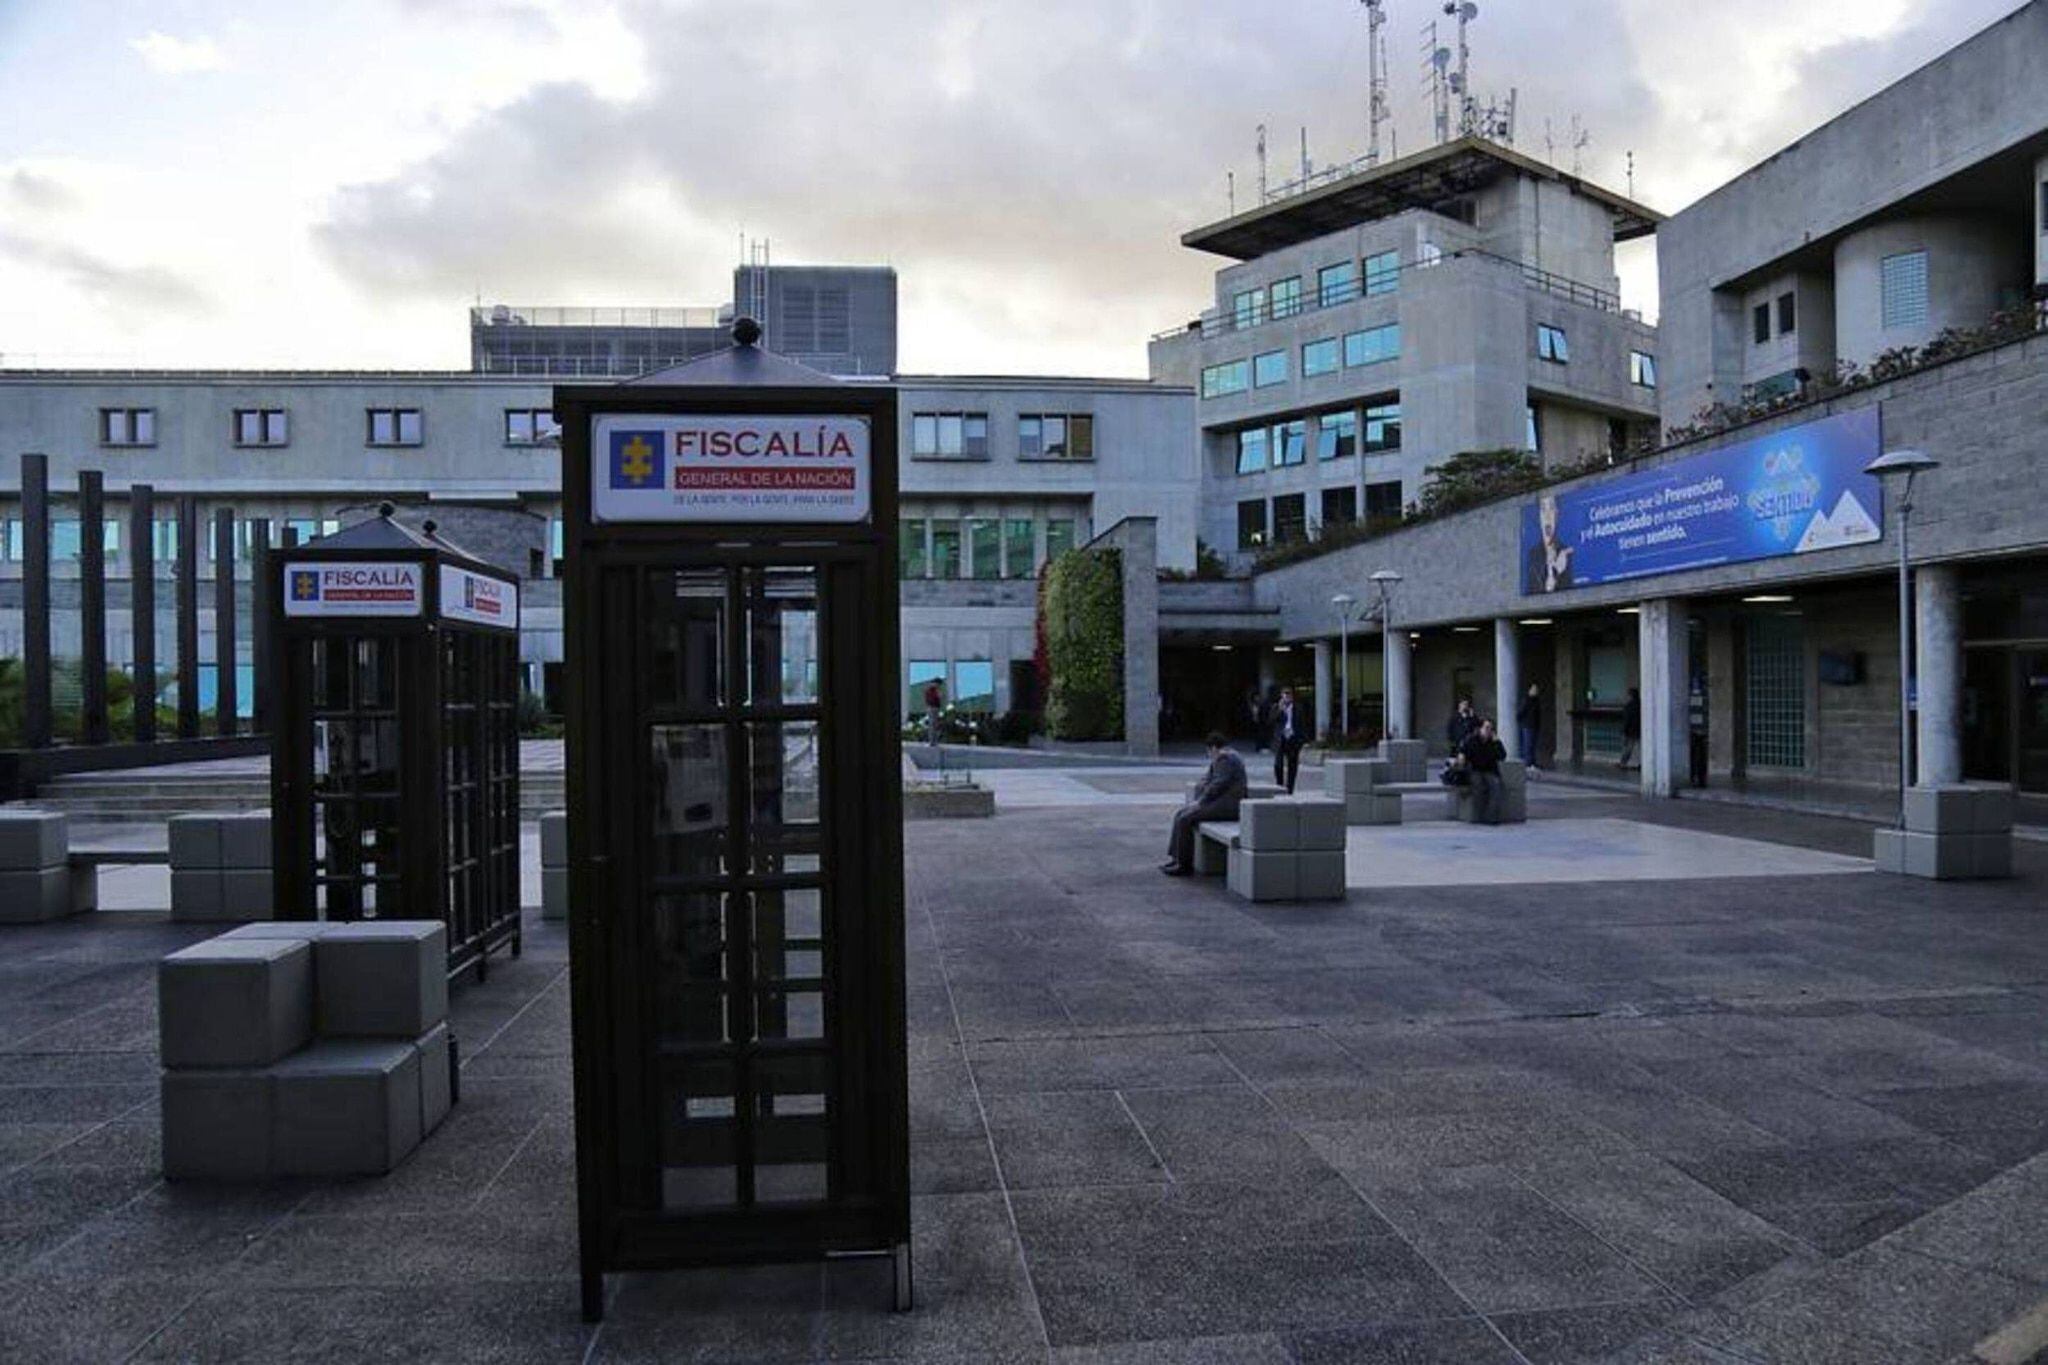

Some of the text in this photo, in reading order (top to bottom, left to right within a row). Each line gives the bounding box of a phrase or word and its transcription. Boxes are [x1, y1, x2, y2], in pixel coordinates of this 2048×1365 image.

[676, 425, 855, 457] FISCALÍA
[679, 470, 851, 486] GENERAL DE LA NACIÓN
[1665, 474, 1724, 504] Prevención
[1594, 512, 1653, 538] Autocuidado
[1667, 503, 1701, 521] nuestro
[1703, 490, 1740, 514] trabajo
[324, 566, 415, 586] FISCALÍA
